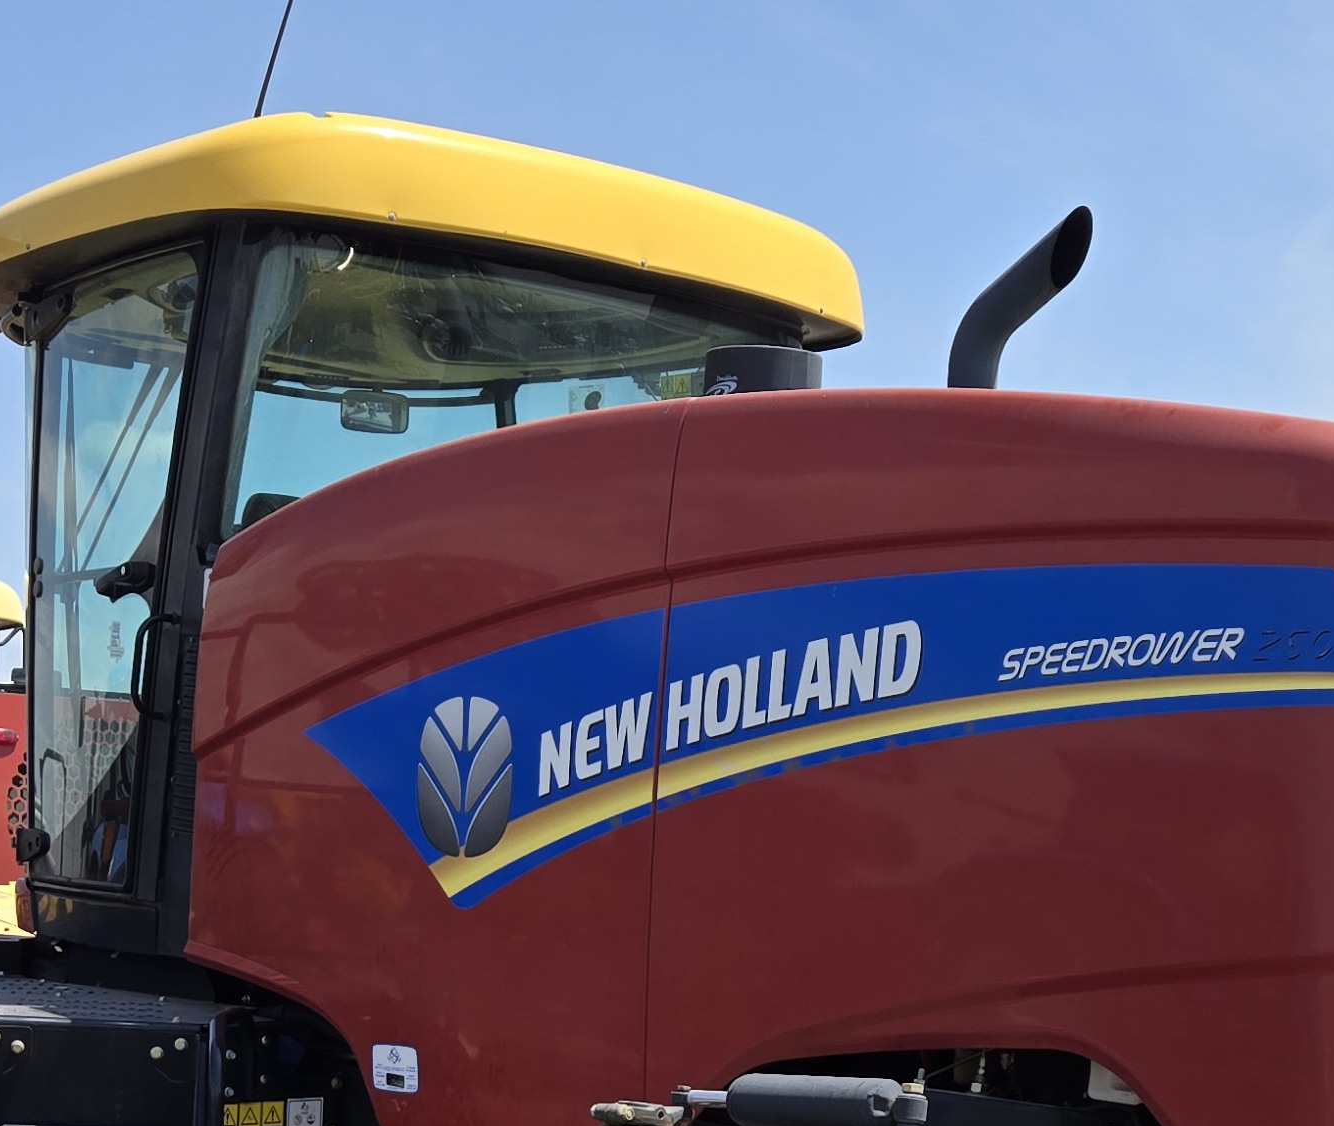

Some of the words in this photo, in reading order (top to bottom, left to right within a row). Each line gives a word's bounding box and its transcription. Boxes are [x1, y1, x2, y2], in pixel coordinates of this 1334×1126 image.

[538, 691, 653, 797] NEW
[666, 619, 923, 751] HOLLAND
[998, 627, 1246, 681] SPEEDROWER
